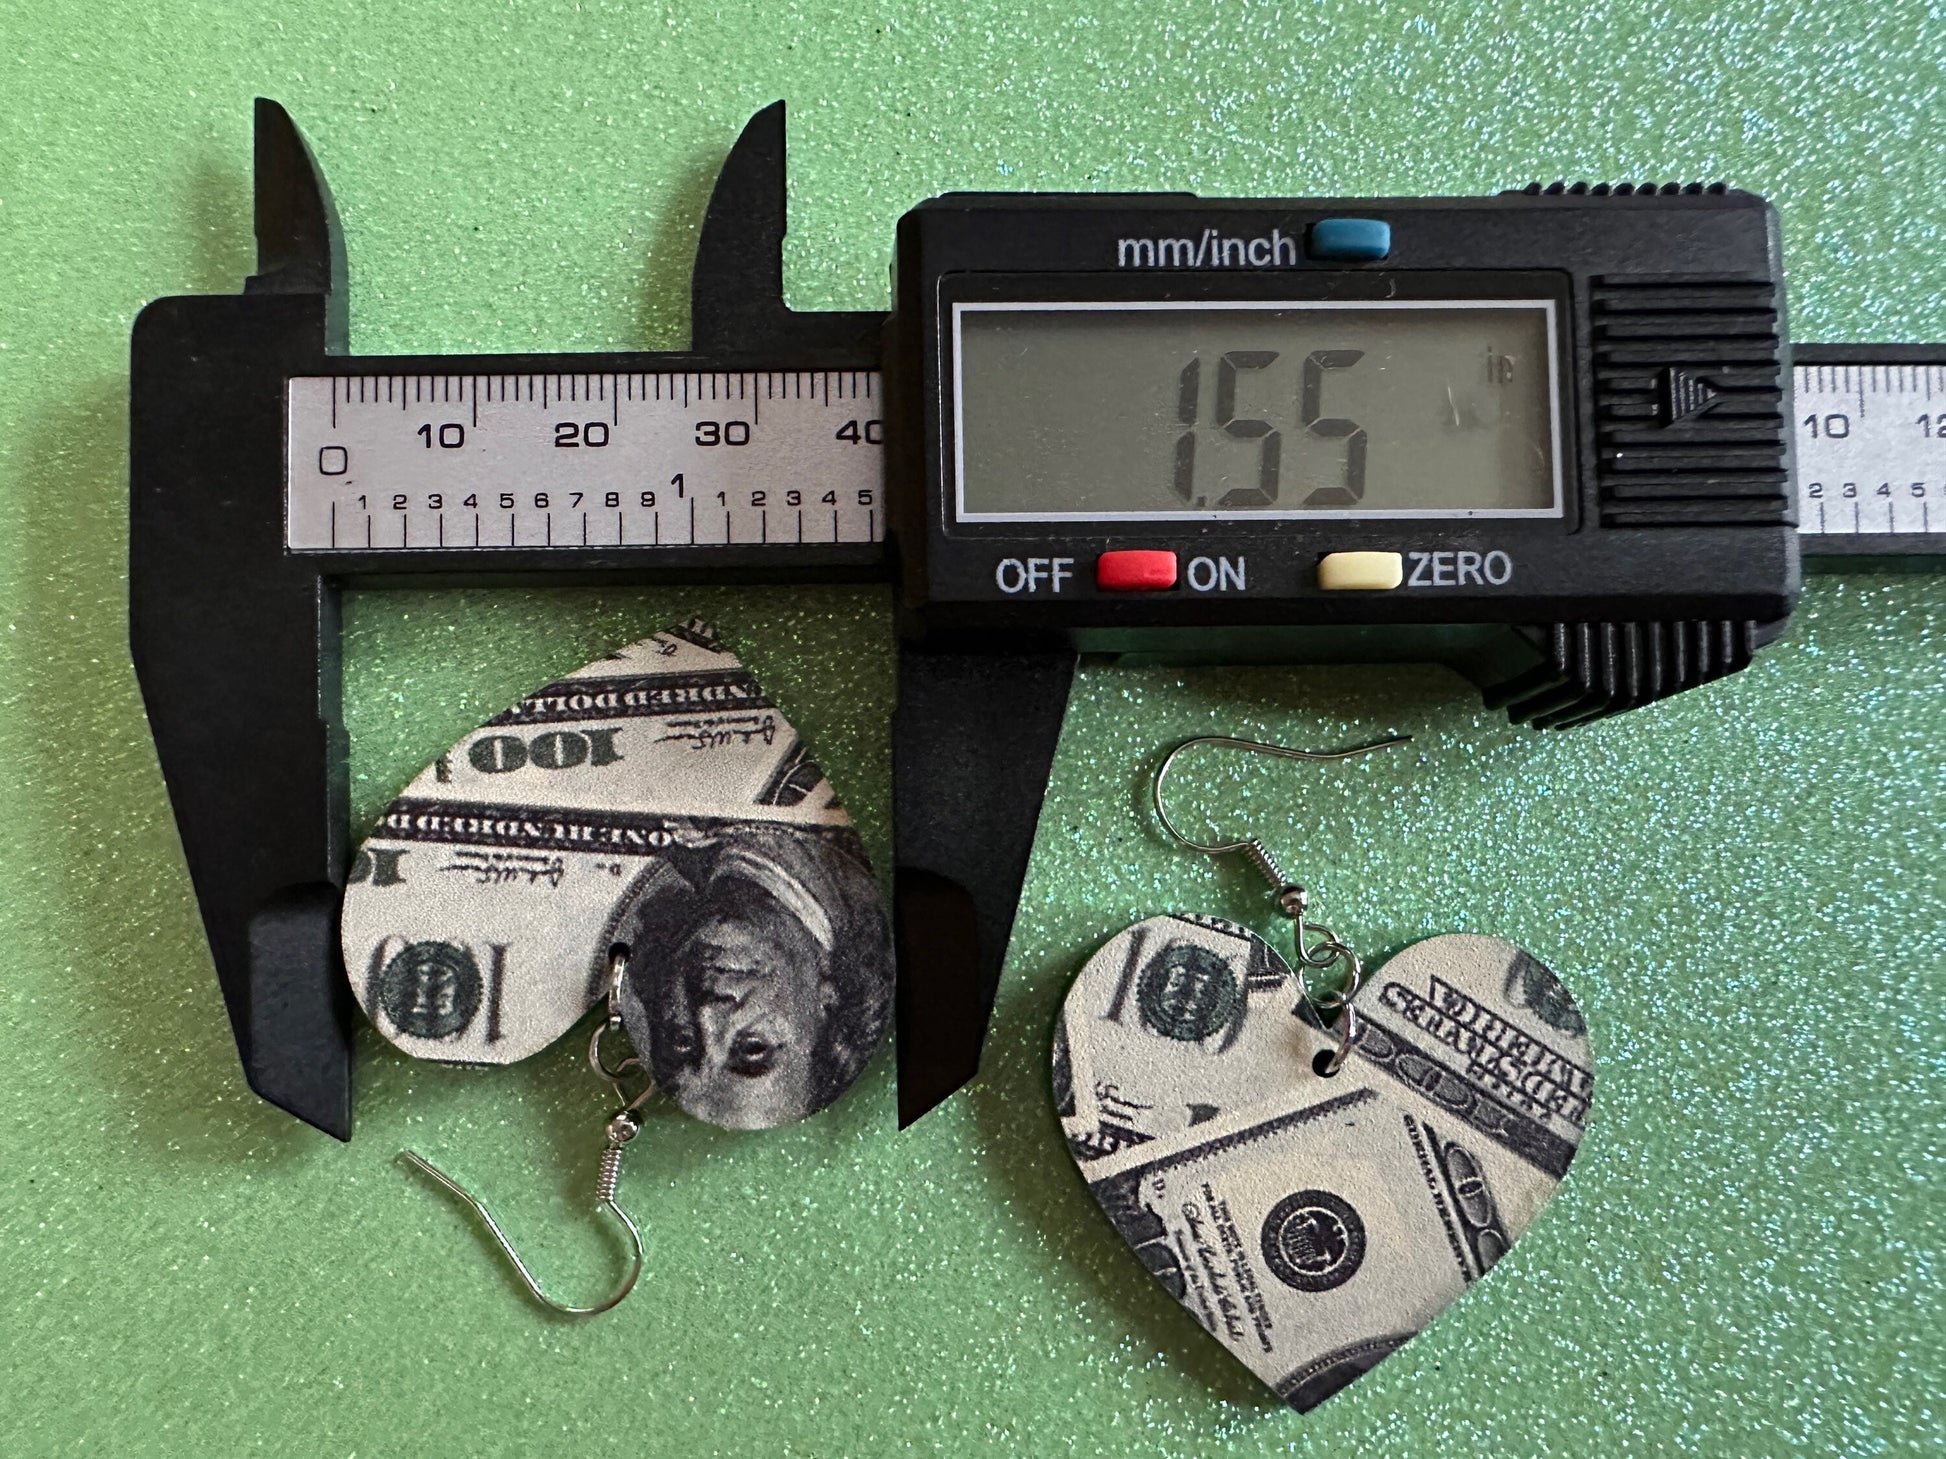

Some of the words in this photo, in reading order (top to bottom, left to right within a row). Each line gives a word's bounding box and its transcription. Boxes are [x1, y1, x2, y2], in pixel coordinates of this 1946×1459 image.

[1118, 229, 1296, 267] mm/inch
[417, 423, 465, 449] 10
[554, 422, 610, 448] 20
[694, 421, 750, 447] 30
[836, 420, 883, 446] 40
[1803, 413, 1850, 439] 10
[319, 446, 349, 476] 0
[359, 495, 367, 510] 1
[393, 495, 408, 510] 2
[428, 494, 443, 510] 3
[463, 493, 478, 509] 4
[499, 493, 514, 509] 5
[534, 493, 549, 508] 6
[569, 493, 583, 508] 7
[605, 492, 620, 508] 8
[640, 492, 655, 508] 9
[671, 473, 684, 499] 1
[717, 491, 726, 506] 1
[751, 491, 767, 507] 2
[786, 490, 802, 506] 3
[822, 490, 837, 506] 4
[858, 489, 873, 505] 5
[1809, 482, 1823, 498] 2
[1843, 482, 1857, 498] 3
[1876, 482, 1891, 498] 4
[1911, 482, 1926, 498] 5
[995, 557, 1075, 593] OFF
[1188, 557, 1246, 592] ON
[1407, 551, 1513, 587] ZERO
[622, 684, 762, 712] NDRED
[468, 728, 623, 775] 100
[597, 825, 673, 846] ONE
